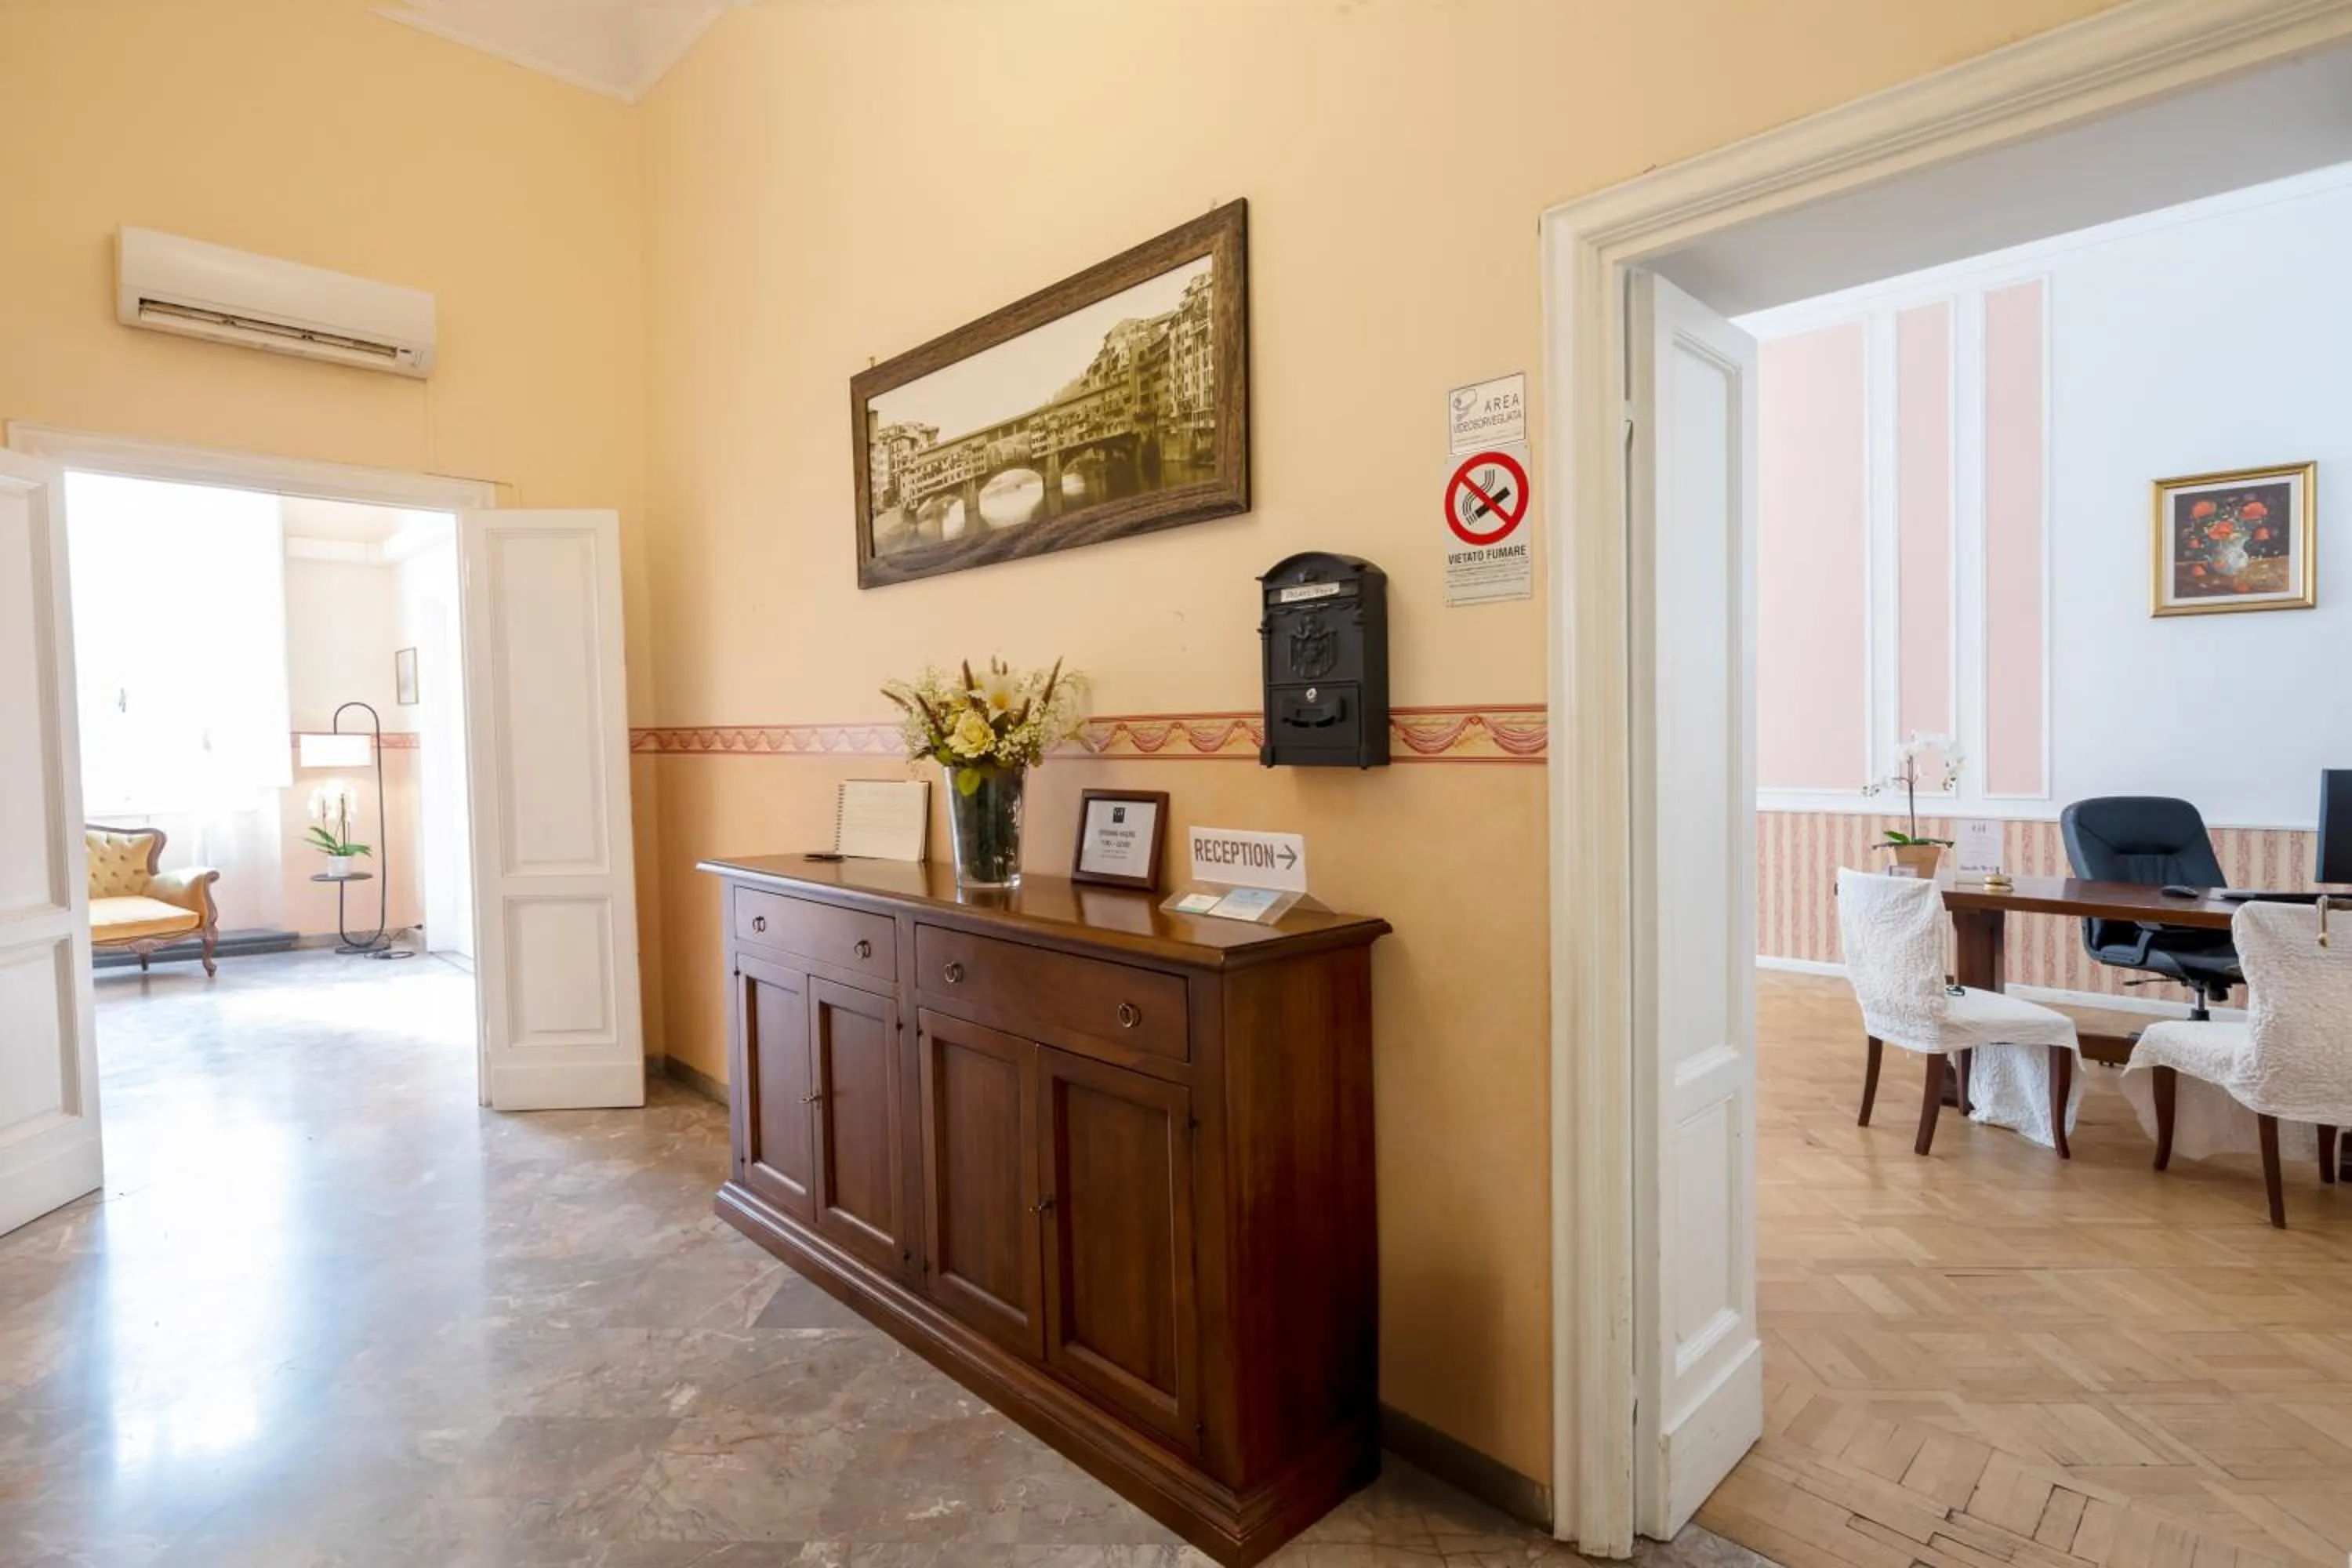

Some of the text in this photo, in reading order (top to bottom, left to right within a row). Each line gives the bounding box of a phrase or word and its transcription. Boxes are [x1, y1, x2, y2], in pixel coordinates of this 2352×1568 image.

[1484, 393, 1519, 412] AREA
[1448, 545, 1526, 564] VIETATO FUMARE
[1194, 838, 1276, 869] RECEPTION
